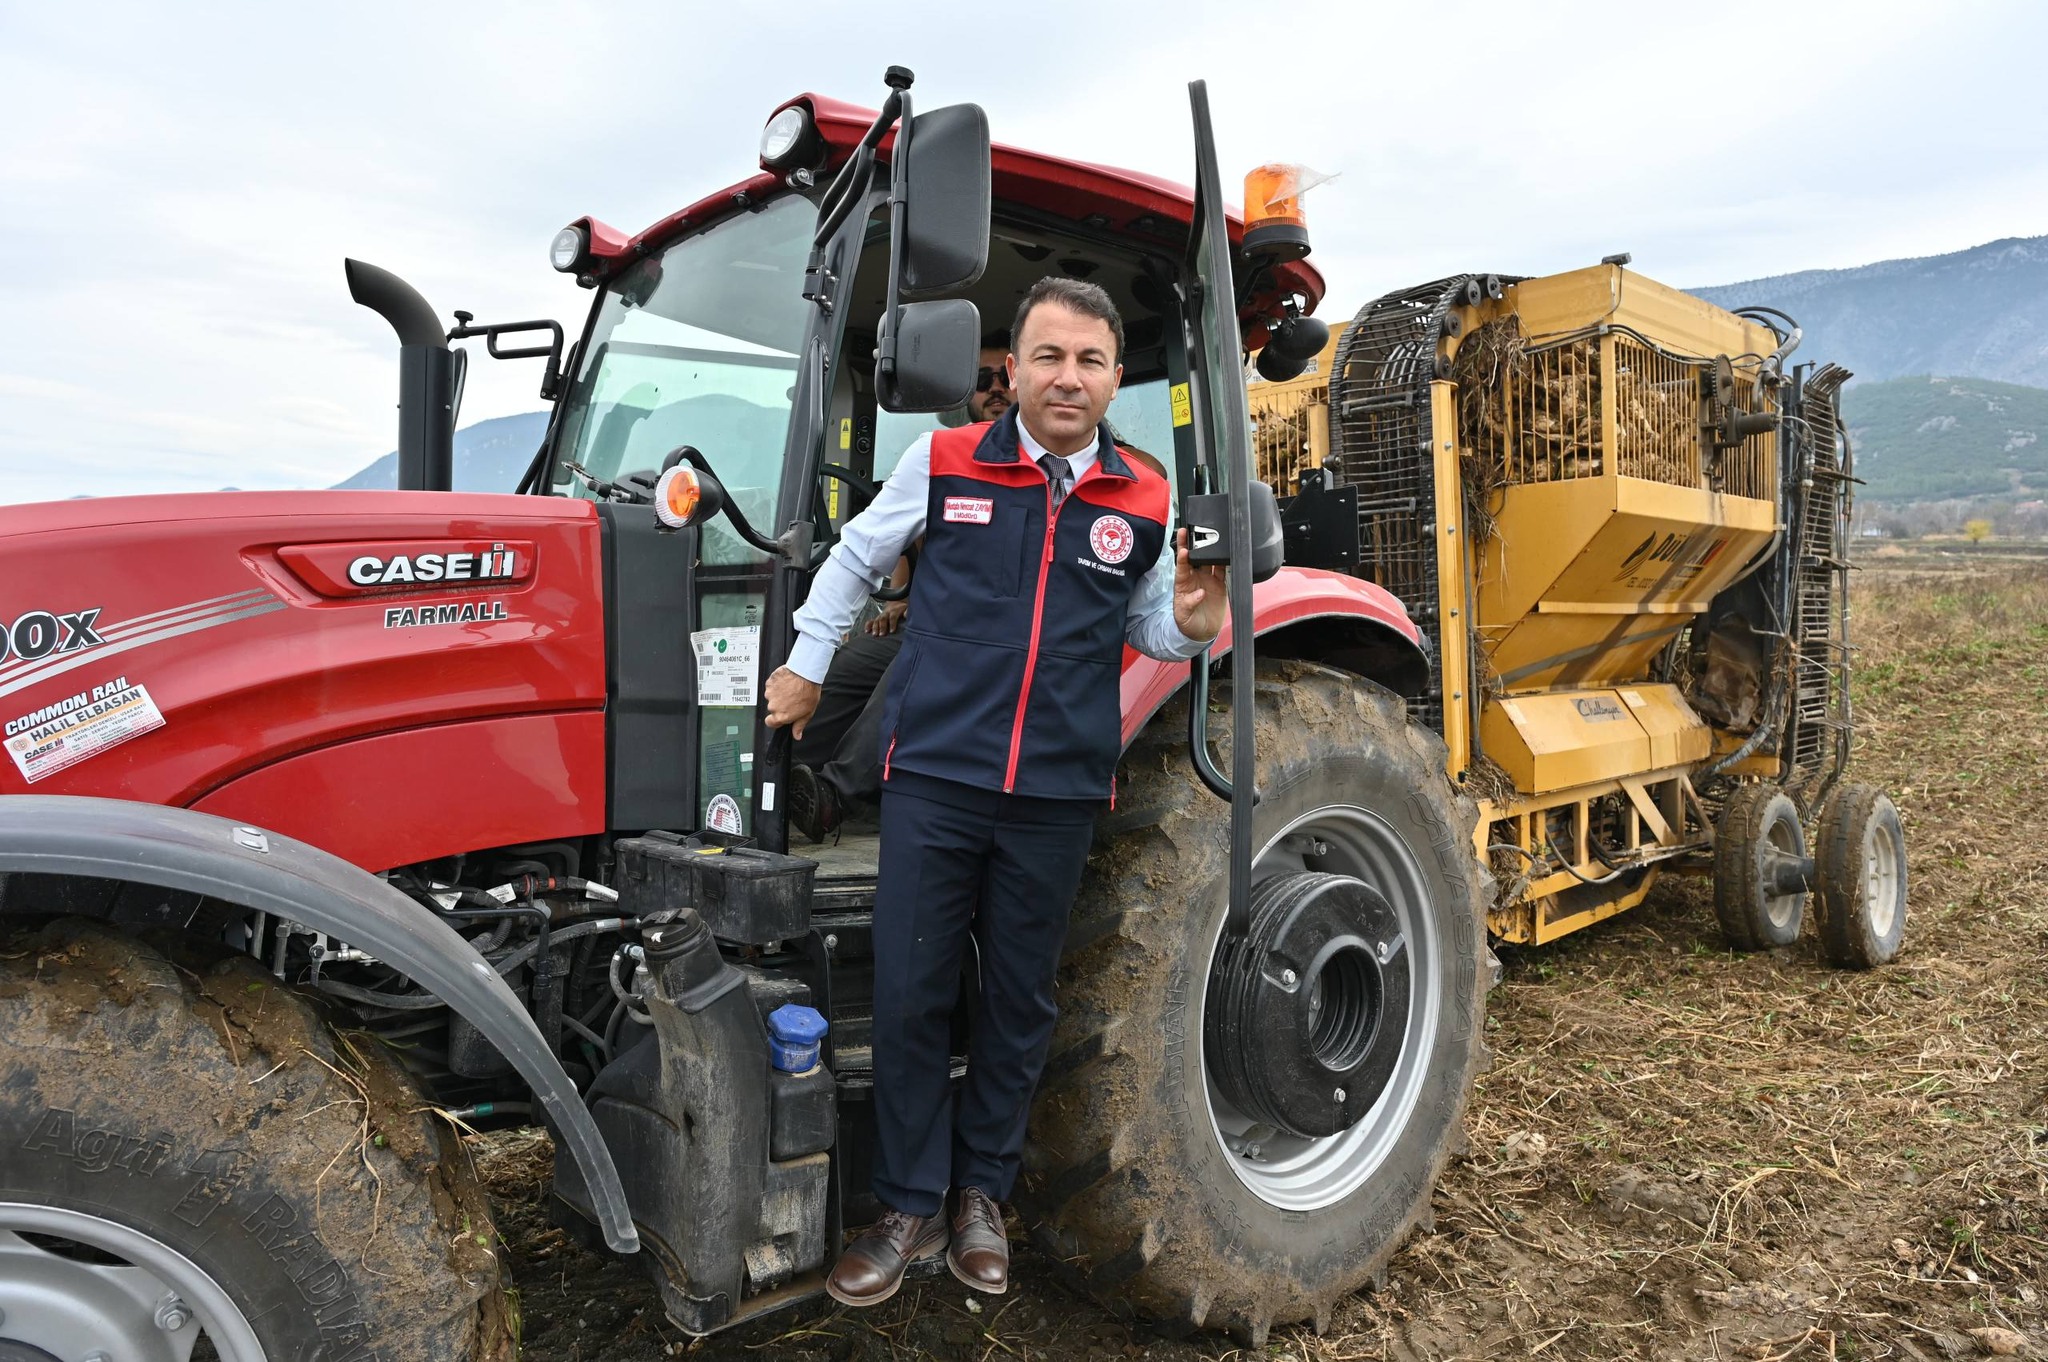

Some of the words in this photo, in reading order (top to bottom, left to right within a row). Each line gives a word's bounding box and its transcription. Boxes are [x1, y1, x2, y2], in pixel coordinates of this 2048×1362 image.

[350, 552, 473, 584] CASE
[384, 601, 507, 629] FARMALL
[5, 691, 89, 736] COMMON
[91, 676, 131, 701] RAIL
[76, 689, 142, 724] ELBASAN
[25, 742, 53, 760] CASE
[1431, 835, 1476, 1043] LASSA
[20, 1105, 177, 1177] Agri
[240, 1191, 380, 1362] RADIA
